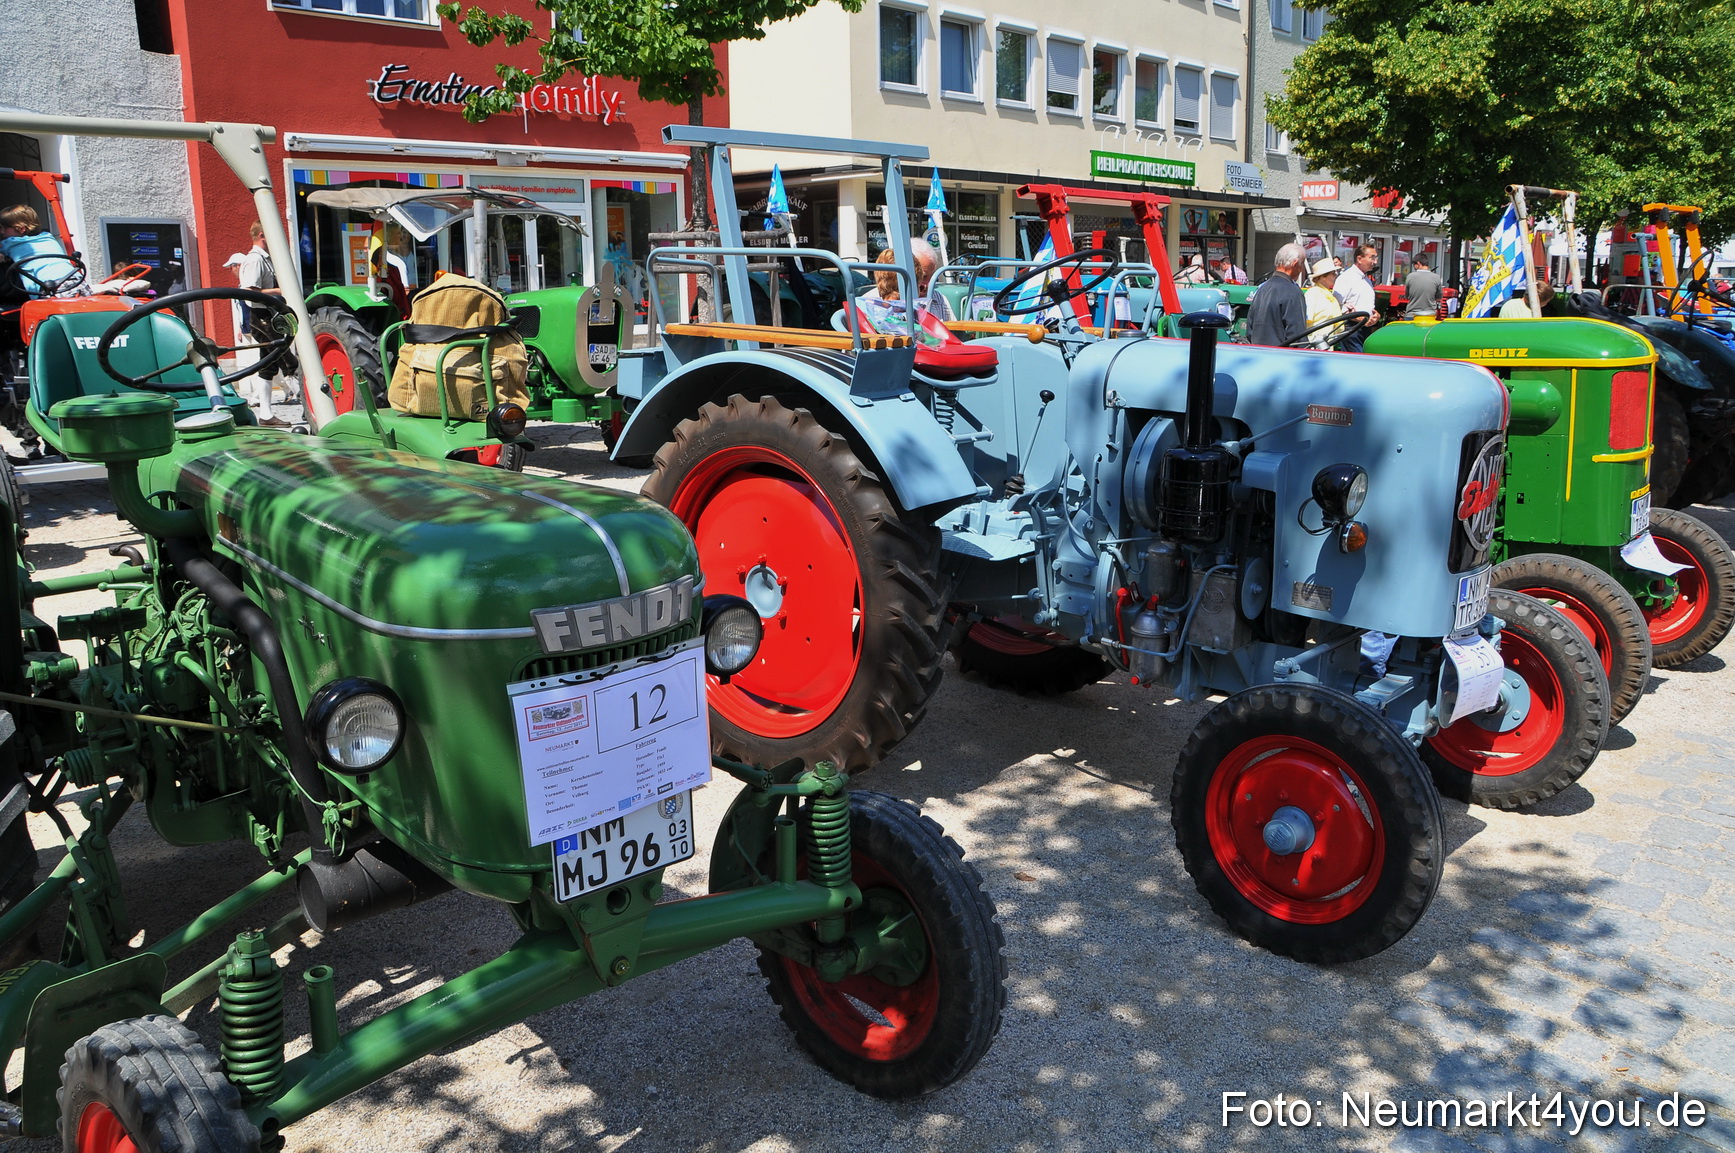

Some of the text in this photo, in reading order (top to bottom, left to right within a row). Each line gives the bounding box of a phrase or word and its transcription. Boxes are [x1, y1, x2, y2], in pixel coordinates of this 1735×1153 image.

[1097, 156, 1193, 180] HEILPRAKTIKERSCHULE
[1227, 164, 1242, 175] FOTO
[521, 185, 545, 193] Familien
[546, 187, 577, 195] empfohlen.
[1230, 178, 1263, 189] STEGMEIER
[1303, 185, 1336, 198] NKD
[961, 232, 980, 241] Kräuter
[984, 233, 996, 241] Tees
[595, 345, 609, 353] SAD
[1469, 348, 1528, 358] DEUTZ
[590, 354, 610, 363] AF 46
[1468, 575, 1482, 600] NM
[535, 577, 694, 652] FENDT
[1459, 602, 1473, 626] TR
[628, 683, 669, 732] 12
[545, 740, 574, 753] NEUMARKT
[635, 737, 657, 750] Fahrzeug
[657, 746, 667, 754] Fendt
[542, 765, 575, 778] Teilnehmer
[544, 783, 558, 791] Name:
[545, 783, 588, 798] Vorname: Thomas
[572, 790, 589, 799] Velburg
[573, 815, 588, 825] DEKRA
[668, 819, 687, 837] 03
[562, 839, 571, 852] D
[561, 832, 688, 897] MJ 96 10
